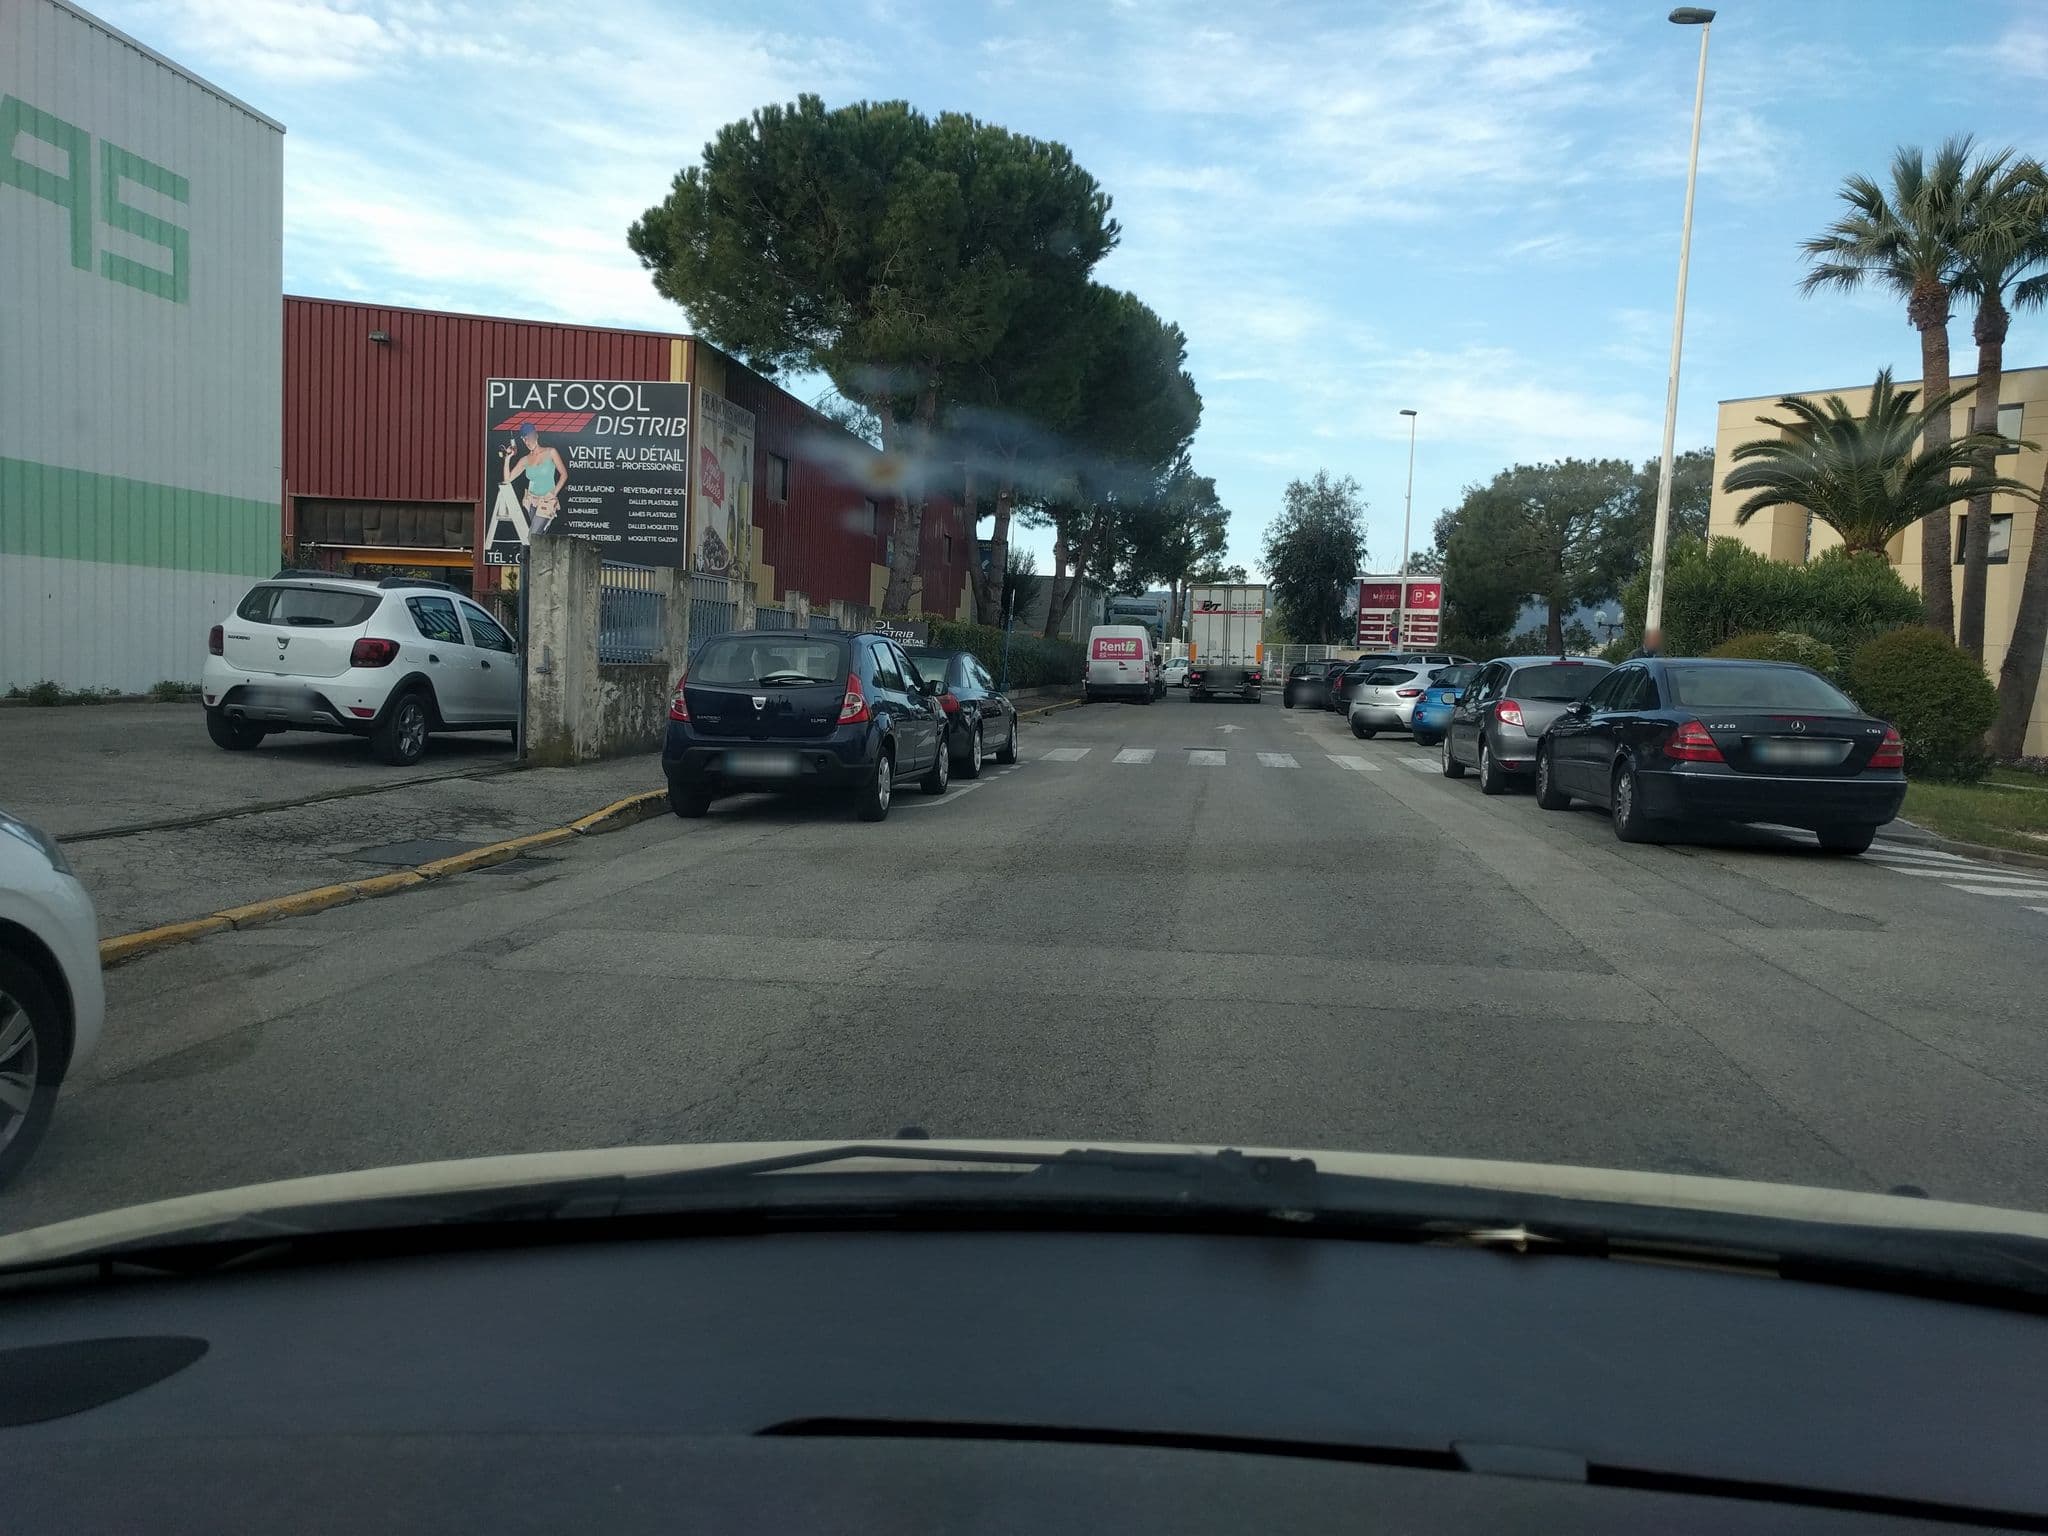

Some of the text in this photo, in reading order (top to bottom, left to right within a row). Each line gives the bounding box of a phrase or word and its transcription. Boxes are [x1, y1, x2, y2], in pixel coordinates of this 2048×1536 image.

[489, 381, 651, 412] PLAFOSOL
[594, 415, 687, 438] DISTRIB
[568, 444, 685, 463] VENTE AU DÉTAIL
[568, 460, 615, 470] PARTICULIER
[621, 462, 684, 472] PROFESSIONNEL
[674, 488, 687, 496] SOL
[647, 499, 679, 507] PLASTIQUES
[590, 534, 622, 542] INTERIEUR
[487, 549, 505, 564] TÉL
[1099, 641, 1136, 652] Rentiz
